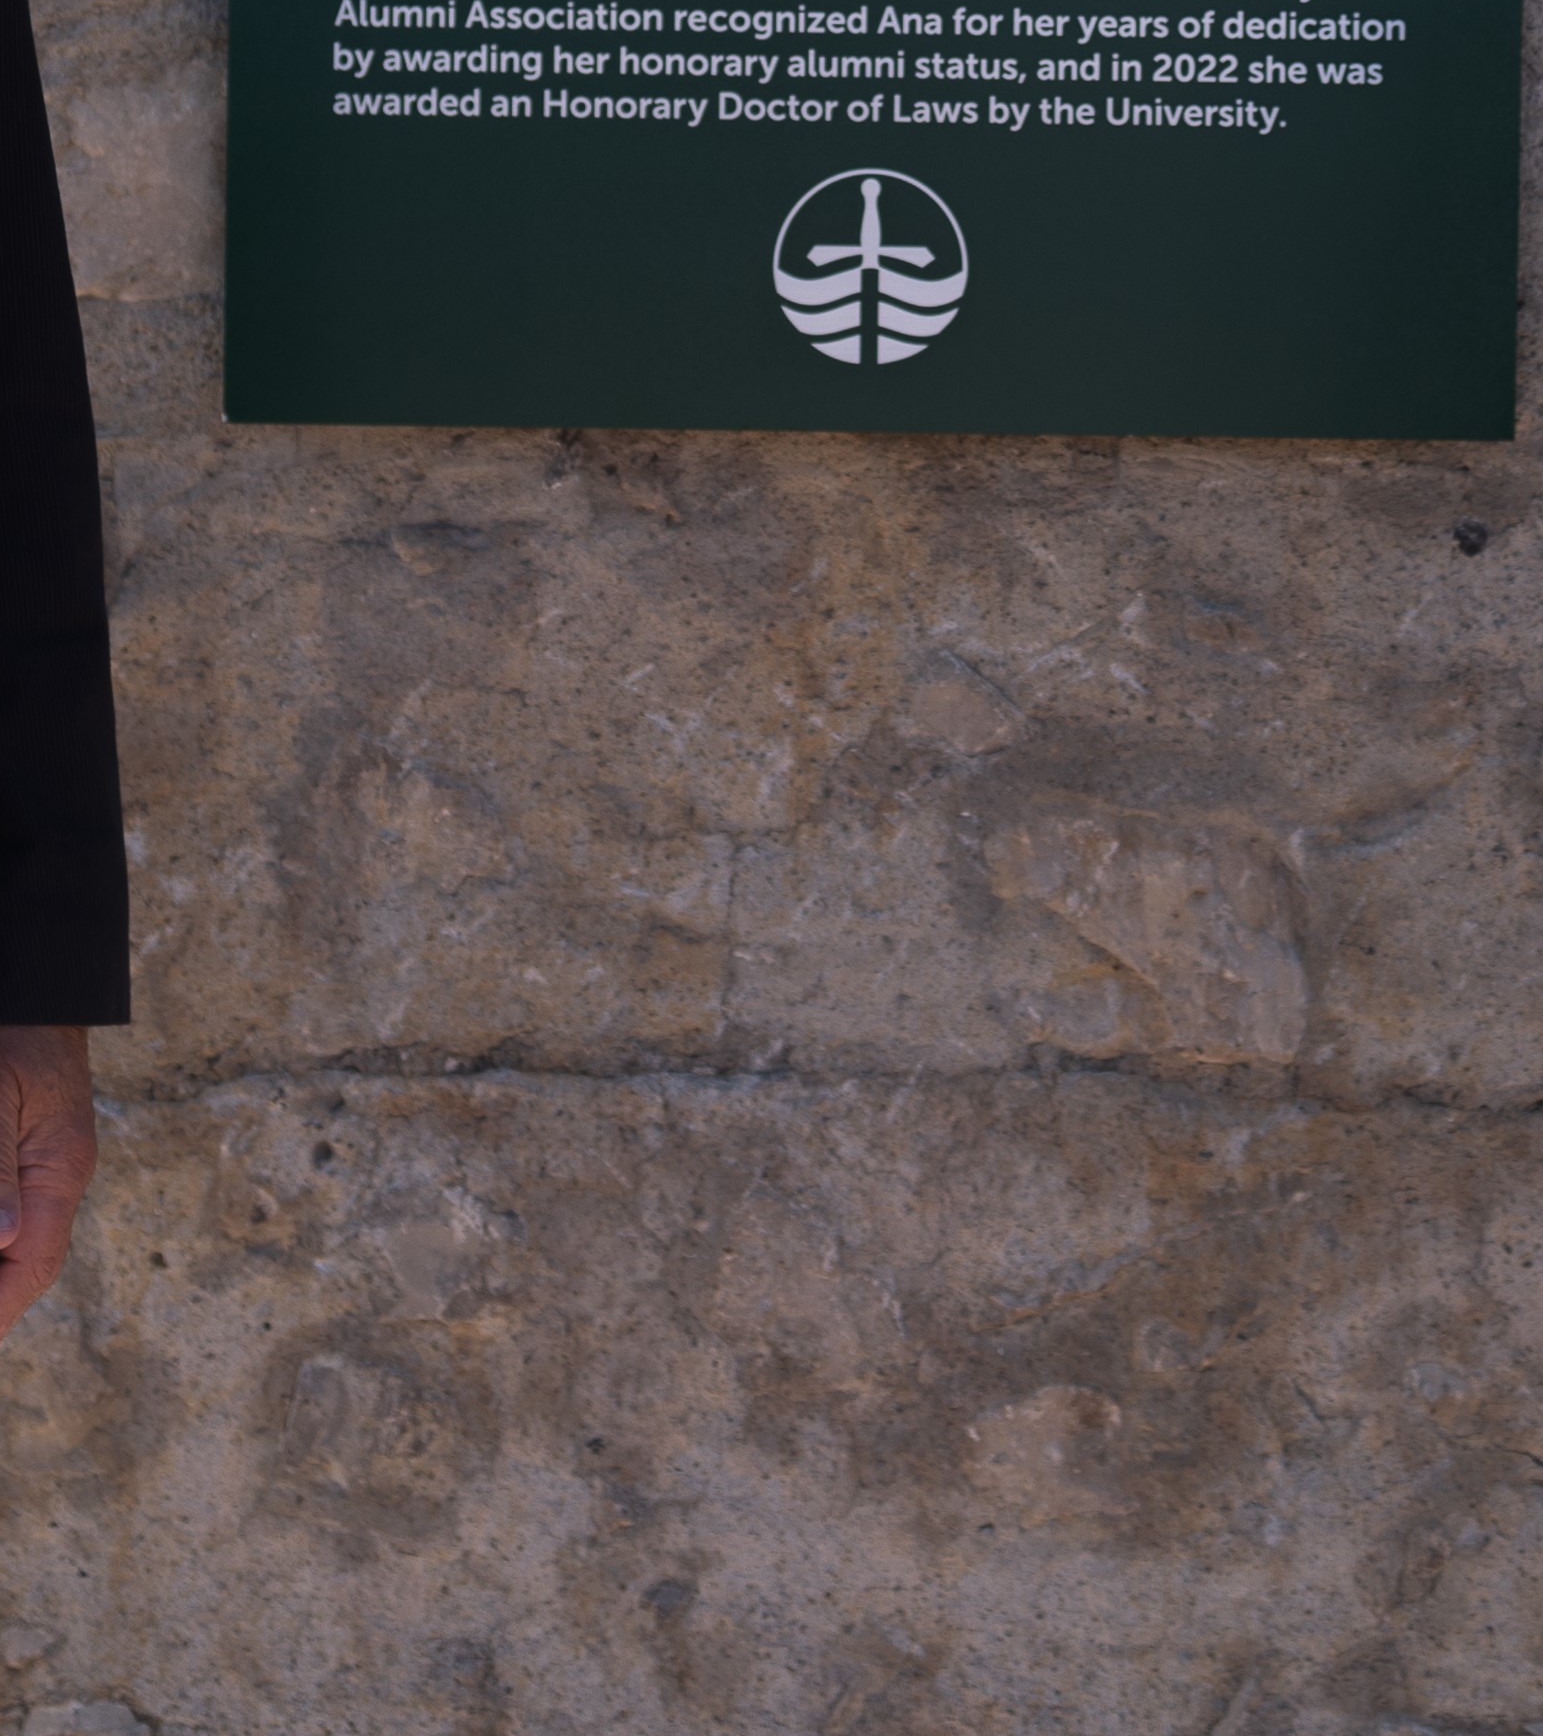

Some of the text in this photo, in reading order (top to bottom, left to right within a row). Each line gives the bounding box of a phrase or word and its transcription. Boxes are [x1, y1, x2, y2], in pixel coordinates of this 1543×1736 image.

[335, 0, 1405, 44] Alumni Association recognized Ana for her years of dedication
[334, 88, 1286, 134] awarded an Honorary Doctor of Laws by the University.
